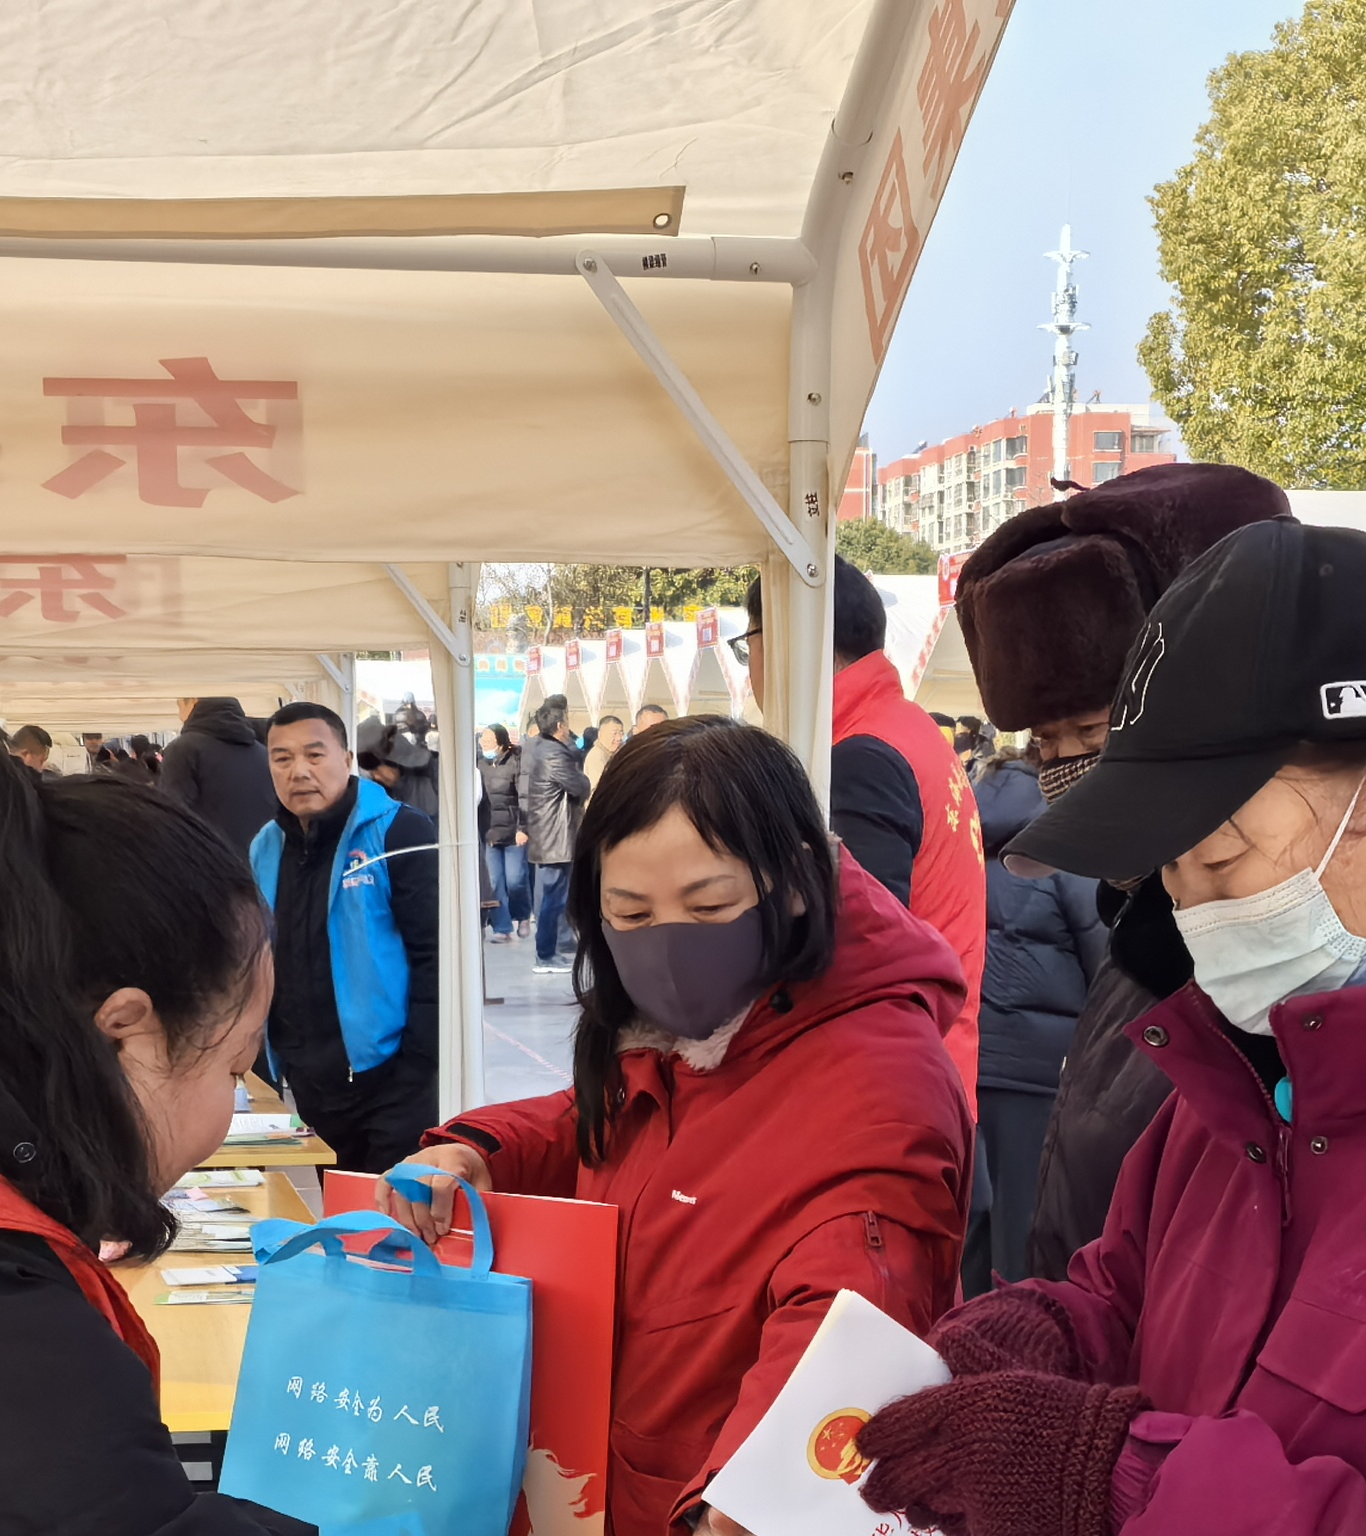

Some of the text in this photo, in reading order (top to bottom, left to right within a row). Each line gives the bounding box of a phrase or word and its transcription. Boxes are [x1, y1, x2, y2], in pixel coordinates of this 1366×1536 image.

[286, 1376, 444, 1433] 网络安全为人民
[274, 1433, 438, 1492] 网络安全靠人民
